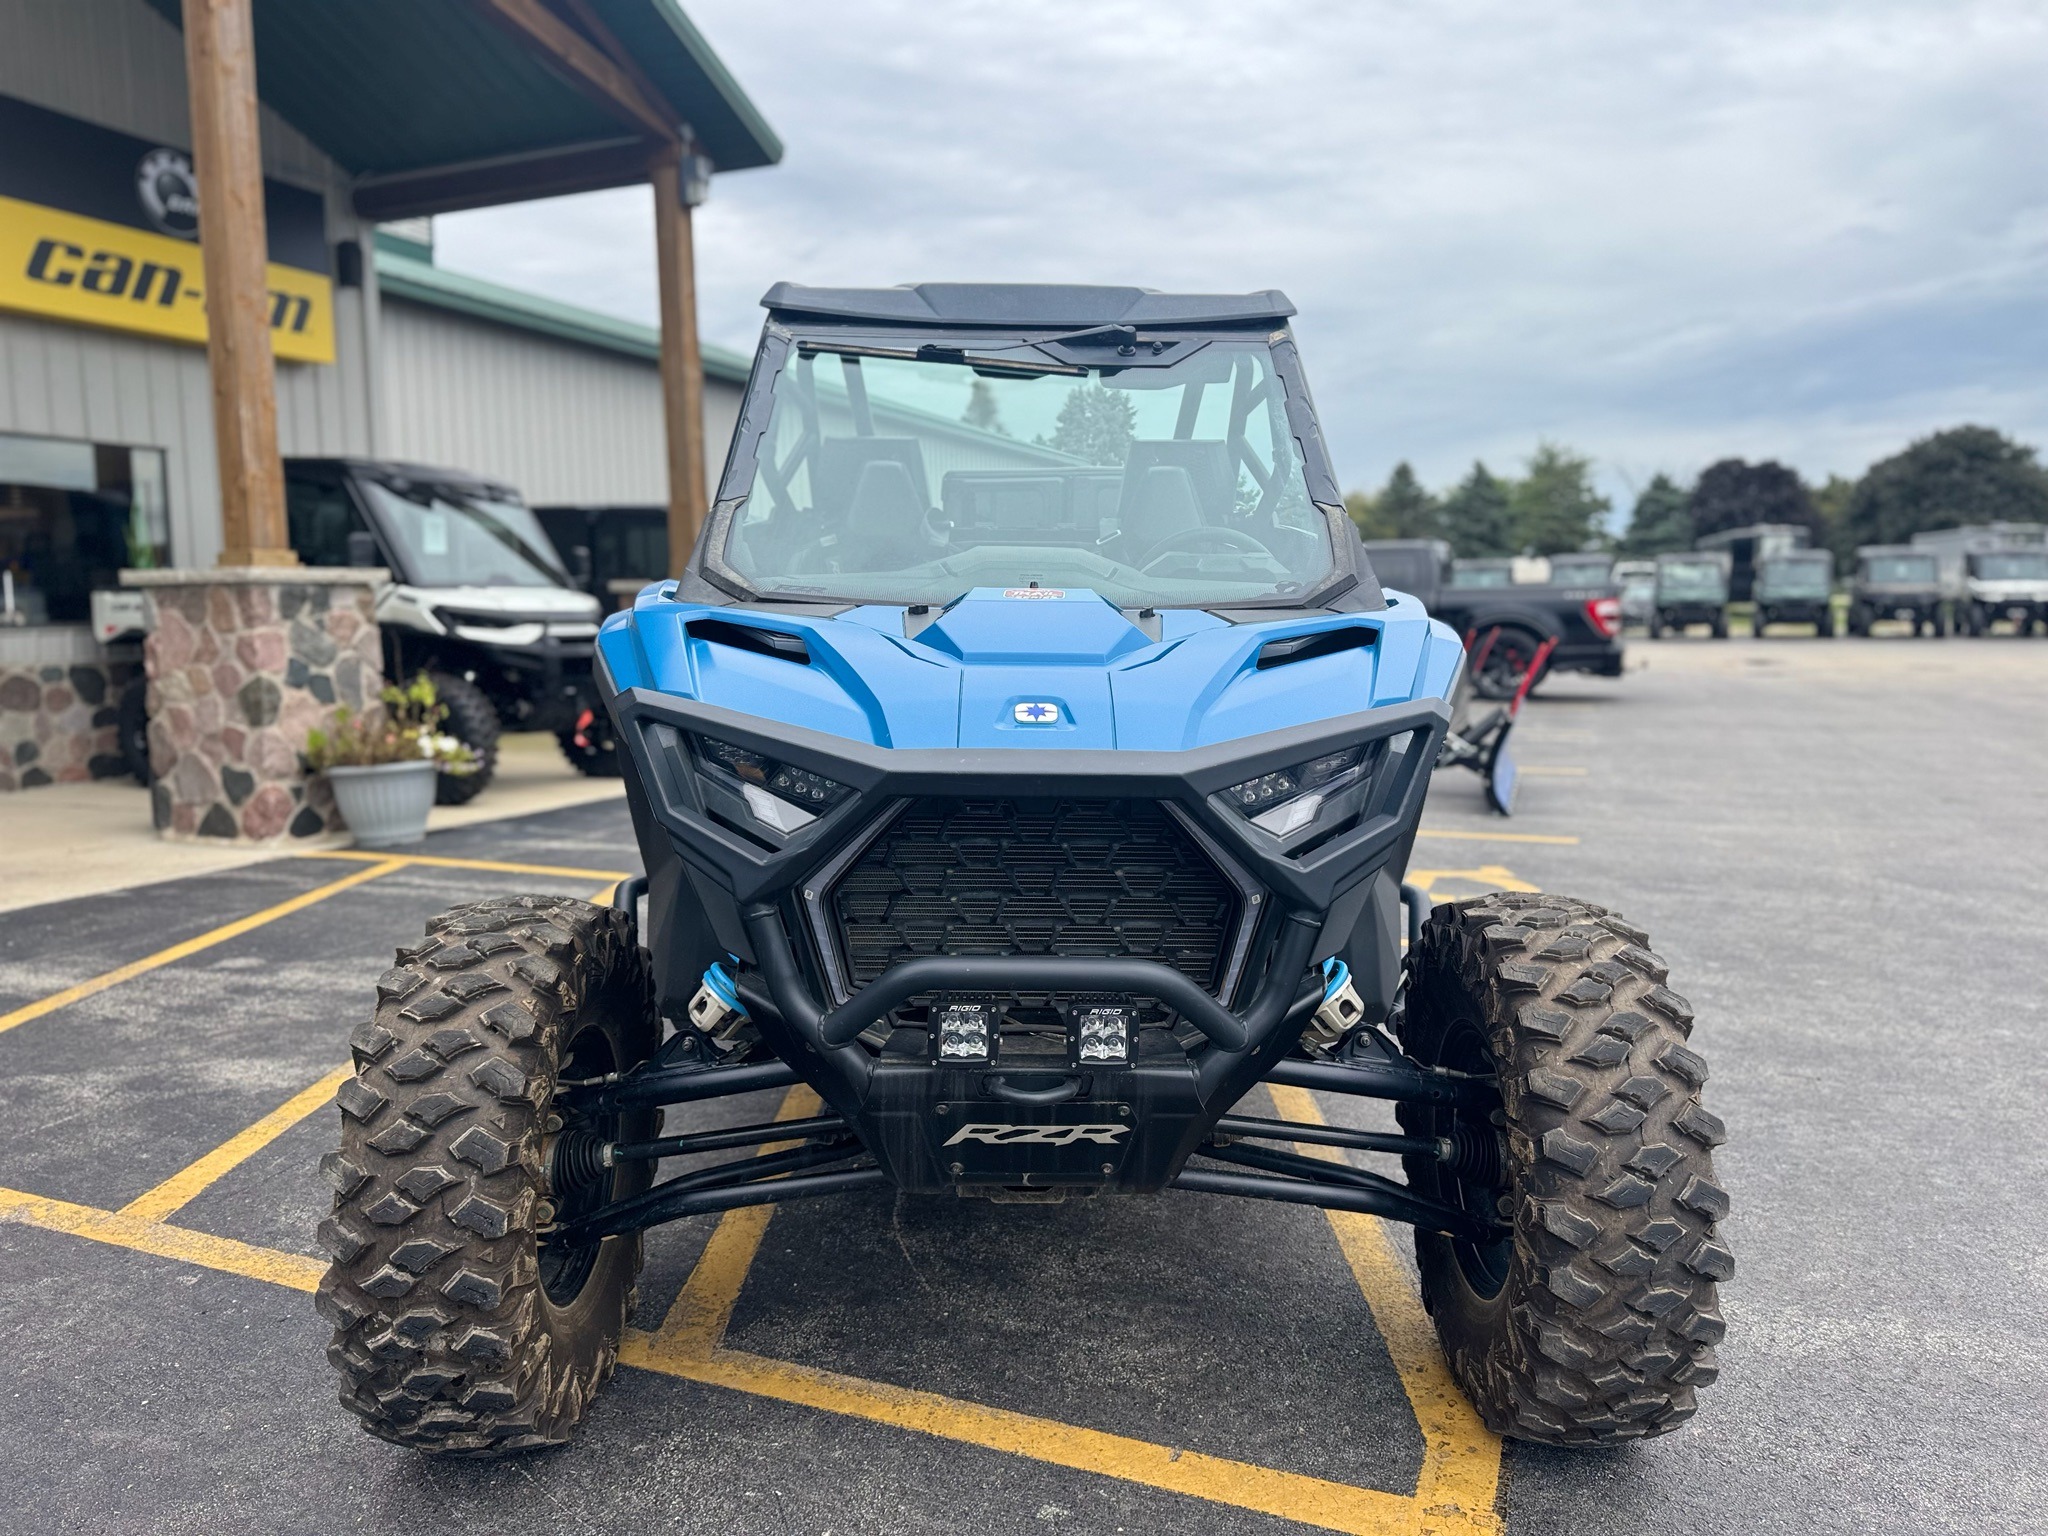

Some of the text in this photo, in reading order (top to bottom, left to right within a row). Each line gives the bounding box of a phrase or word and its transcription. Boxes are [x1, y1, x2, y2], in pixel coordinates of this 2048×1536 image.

[25, 238, 313, 333] can-m
[948, 1004, 982, 1012] RIGID
[942, 1123, 1131, 1147] RZR
